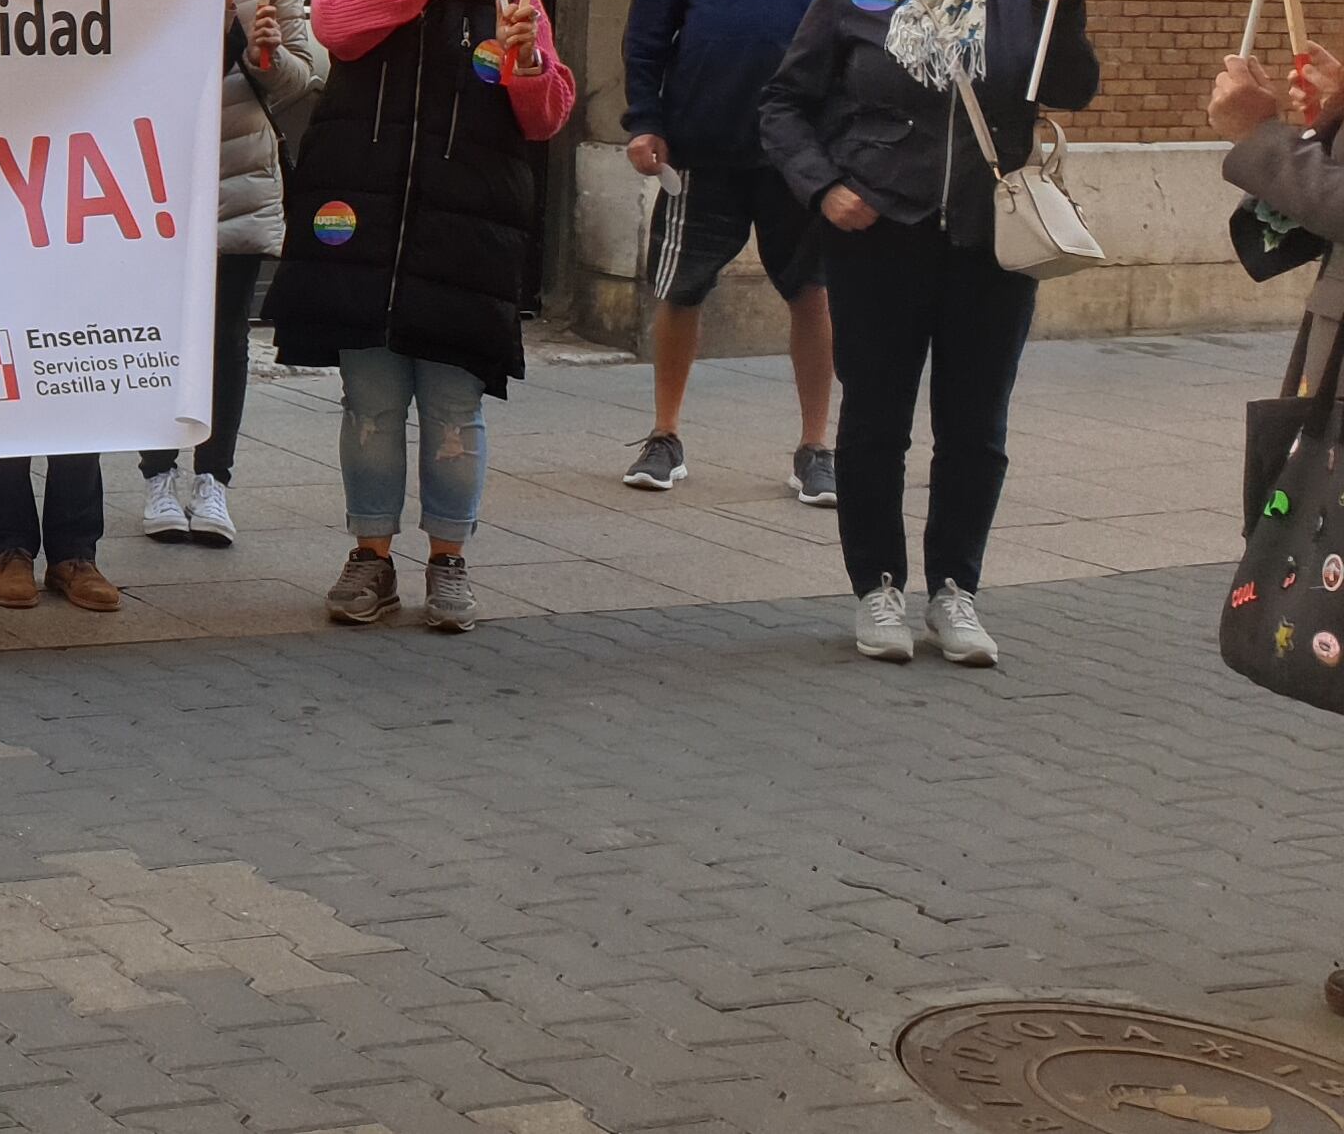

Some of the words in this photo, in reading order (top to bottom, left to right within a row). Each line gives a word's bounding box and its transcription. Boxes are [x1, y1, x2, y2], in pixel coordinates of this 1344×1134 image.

[26, 324, 161, 349] Enseñanza
[33, 355, 118, 376] Servicios
[123, 351, 181, 372] Públic
[35, 375, 107, 397] Castilla
[111, 378, 122, 395] y
[126, 370, 172, 390] León
